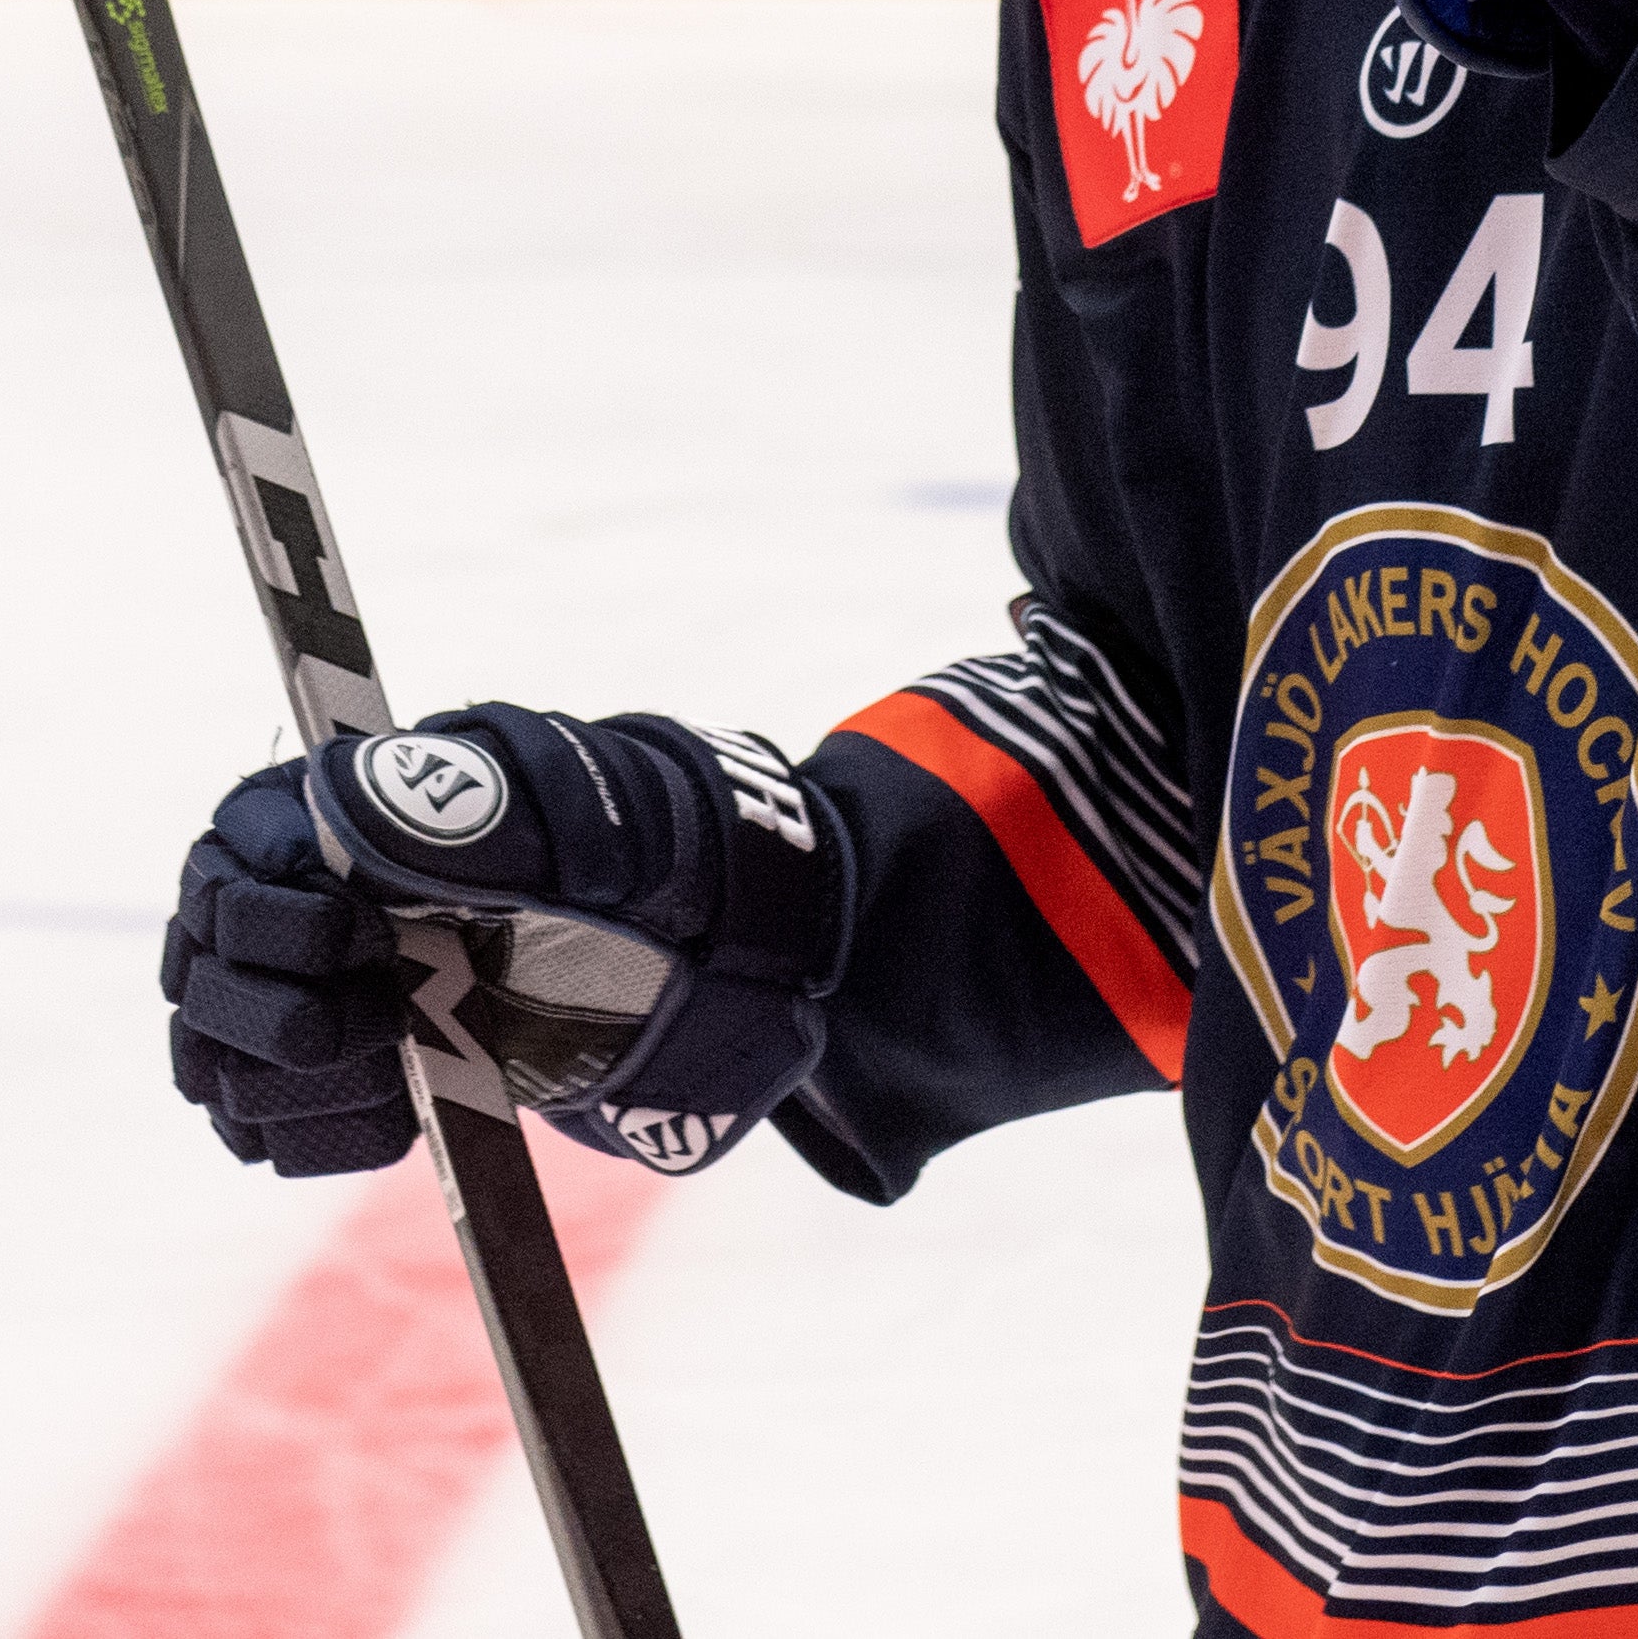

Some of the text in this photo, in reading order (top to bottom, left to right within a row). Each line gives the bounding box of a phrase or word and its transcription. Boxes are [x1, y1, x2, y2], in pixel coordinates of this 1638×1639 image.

[1295, 192, 1546, 452] 94
[1244, 671, 1324, 926] VÄXJÖ
[1309, 565, 1498, 685] LAKERS
[1273, 1056, 1393, 1244] SORT
